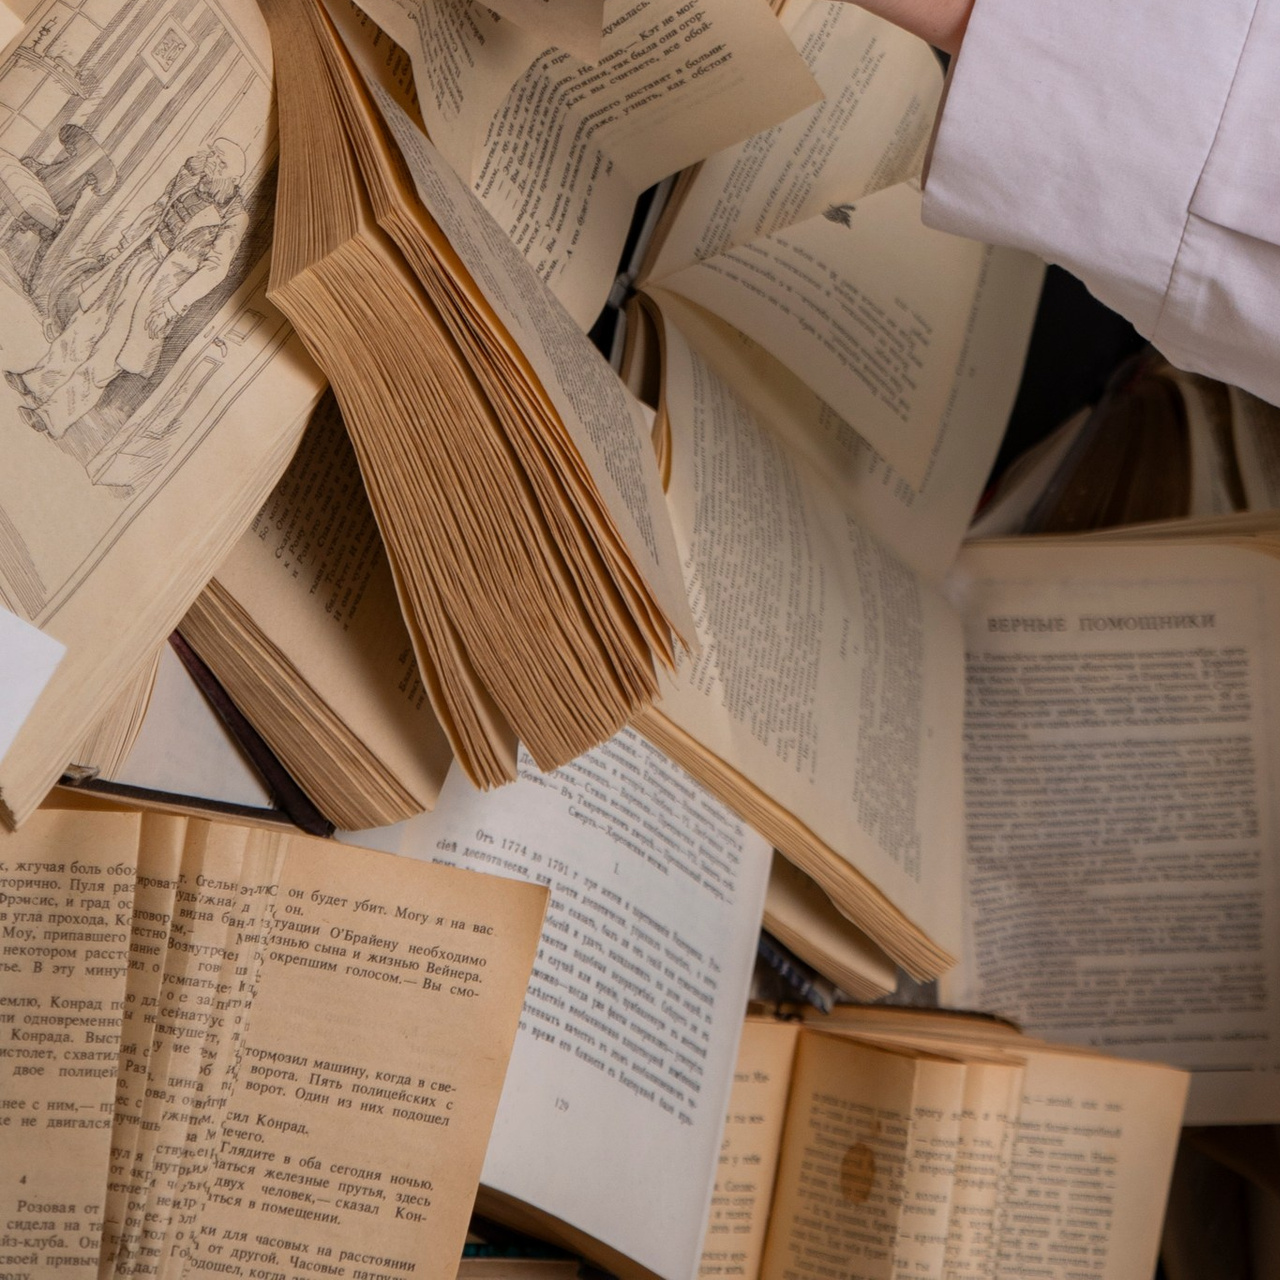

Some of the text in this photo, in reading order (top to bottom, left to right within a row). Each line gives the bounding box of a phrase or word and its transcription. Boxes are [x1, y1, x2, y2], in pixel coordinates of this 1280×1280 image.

[639, 25, 659, 41] Кэт
[661, 15, 675, 27] не
[630, 42, 658, 60] была
[659, 29, 678, 44] она
[564, 93, 587, 110] Как
[590, 84, 605, 94] вы
[663, 42, 681, 56] все
[666, 78, 687, 91] как
[691, 52, 732, 79] обстоят
[987, 614, 1215, 632] ВЕРНЫЕ ПОМОЩНИКИ
[15, 862, 102, 875] жгучая боль
[12, 911, 109, 927] угла прохода,
[288, 889, 494, 935] он будет убит. Могу я на вас
[2, 927, 127, 946] Моу, припавшего
[314, 944, 482, 983] сына и жизнью Вейнера.
[408, 945, 487, 967] необходимо
[269, 951, 338, 972] окрепшим
[422, 977, 442, 992] Вы
[450, 986, 479, 997] смо-
[250, 1065, 453, 1110] ворота. Пять полицейских с
[313, 1060, 456, 1093] машину, когда в све-
[245, 1081, 450, 1126] ворот. Один из них подошел
[21, 1117, 111, 1133] не двигался
[256, 1113, 309, 1135] Конрад.
[220, 1141, 433, 1191] Глядите в оба сегодня ночью.
[19, 1175, 26, 1185] 4
[263, 1169, 431, 1207] железные прутья, здесь
[17, 1200, 76, 1214] Розовая
[248, 1200, 340, 1225] в помещении.
[335, 1199, 427, 1222] сказал Кон-
